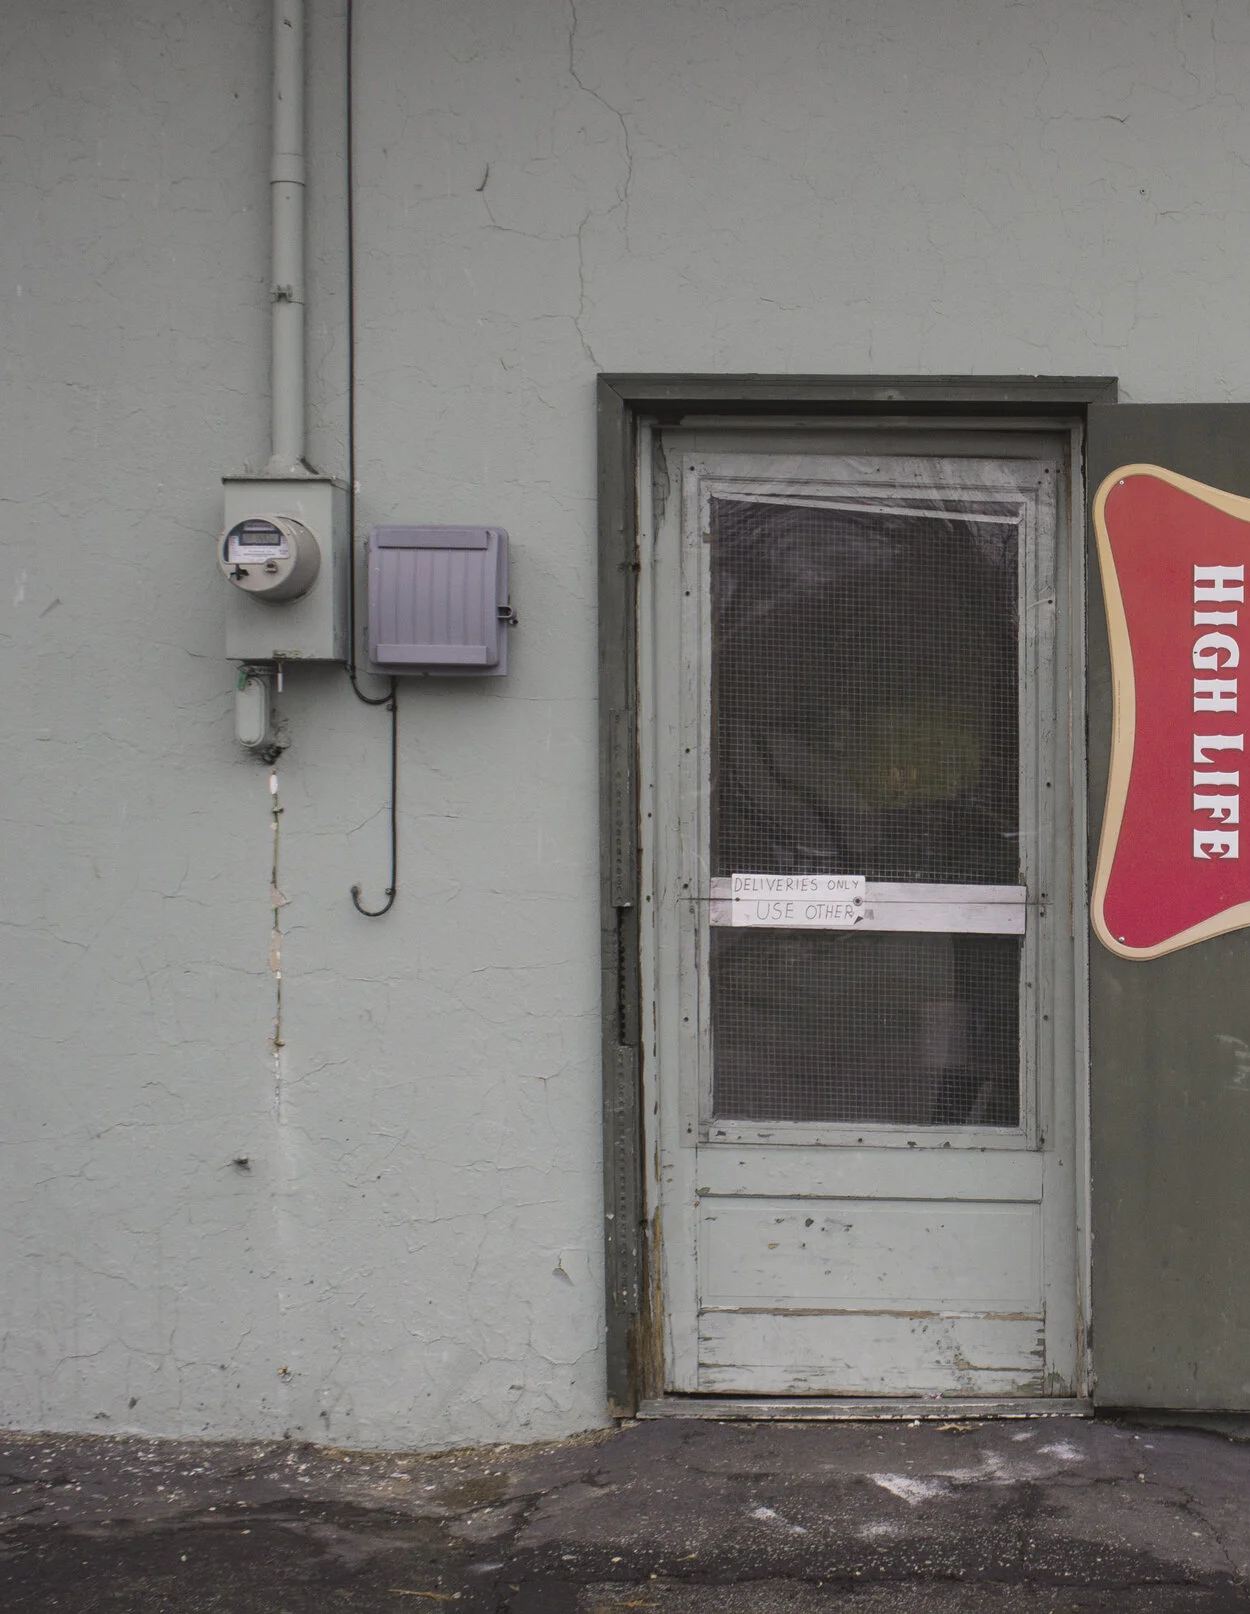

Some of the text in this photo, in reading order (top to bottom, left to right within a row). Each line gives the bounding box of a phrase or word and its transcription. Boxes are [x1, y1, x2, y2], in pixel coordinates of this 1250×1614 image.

[1192, 564, 1245, 860] HIGH LIFE
[734, 878, 859, 892] DELIVERIES ONLY
[756, 902, 853, 921] USE OTHER
